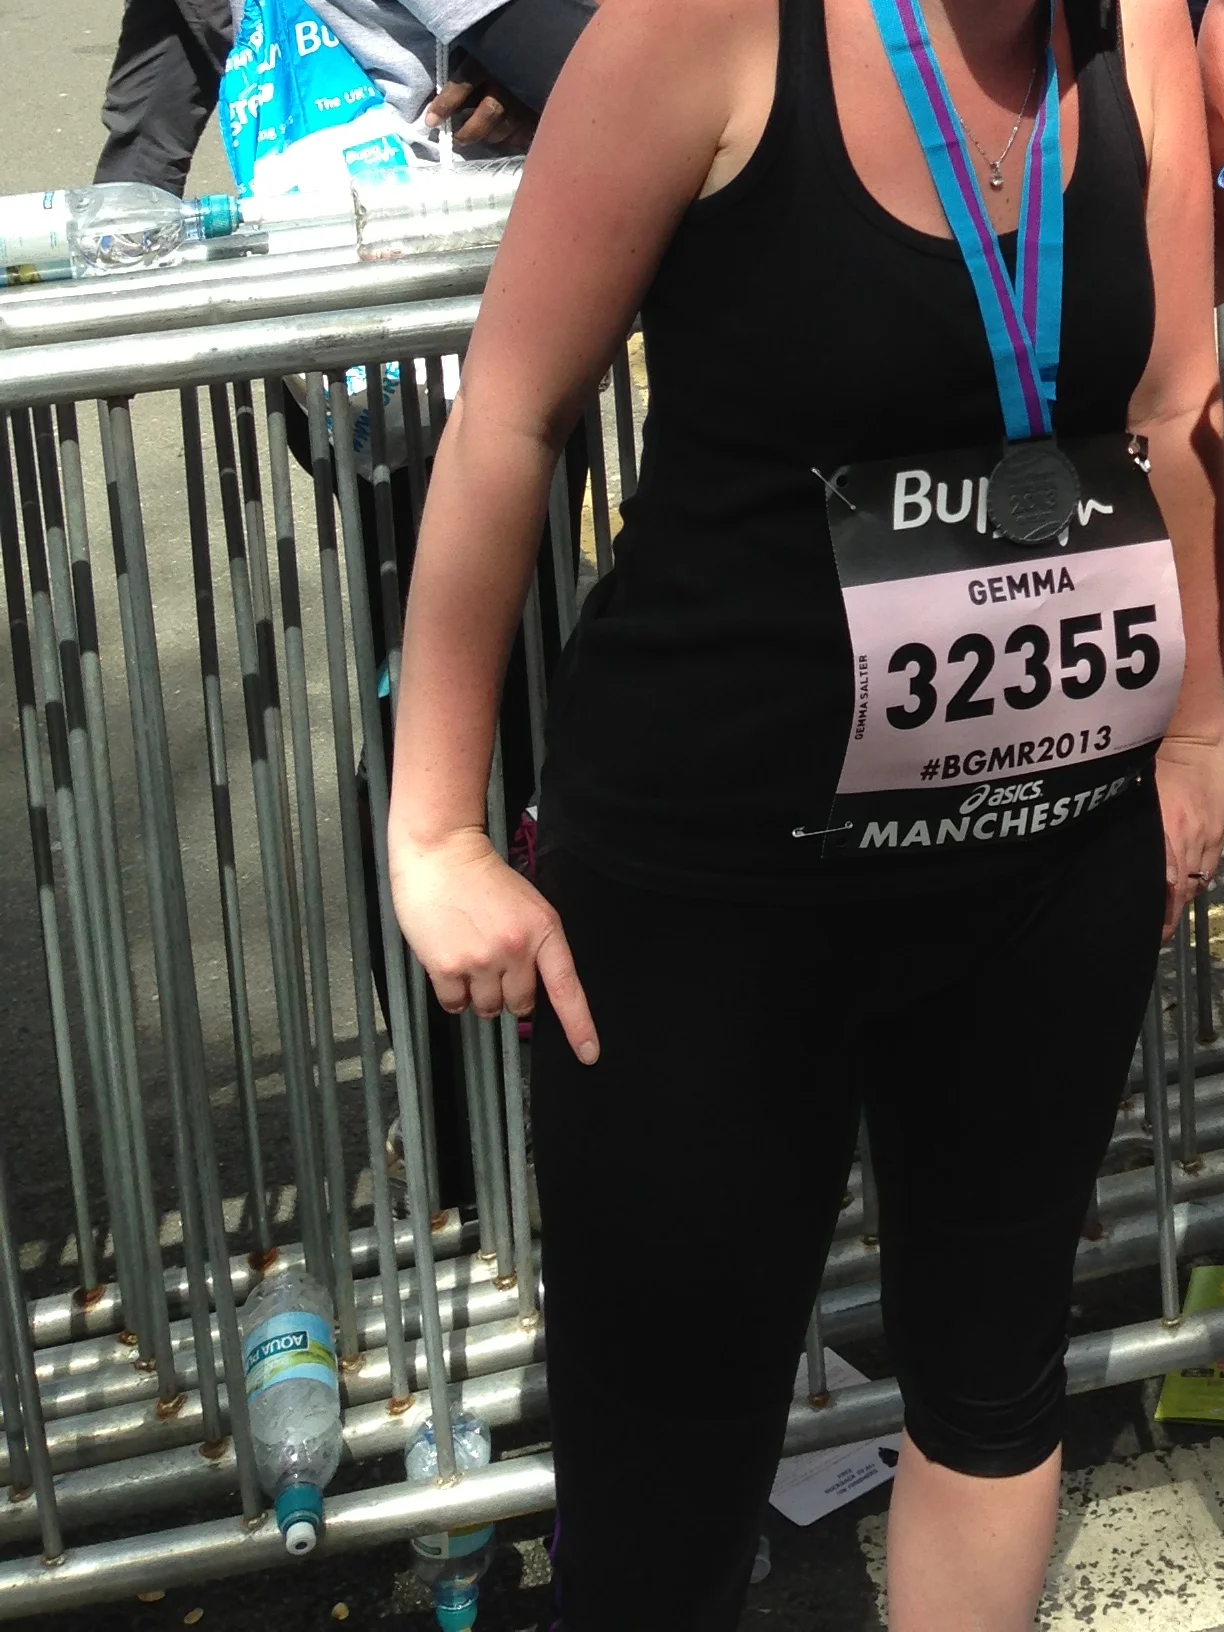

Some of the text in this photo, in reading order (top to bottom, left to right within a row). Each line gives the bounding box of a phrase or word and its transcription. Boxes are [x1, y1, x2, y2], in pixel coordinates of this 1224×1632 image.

[968, 566, 1076, 606] GEMMA
[854, 654, 869, 741] GEMMA SALTER
[885, 604, 1161, 731] 32355
[920, 725, 1112, 782] #BGMR2013
[858, 776, 1126, 849] MANCHESTER
[261, 1334, 304, 1354] AQUA
